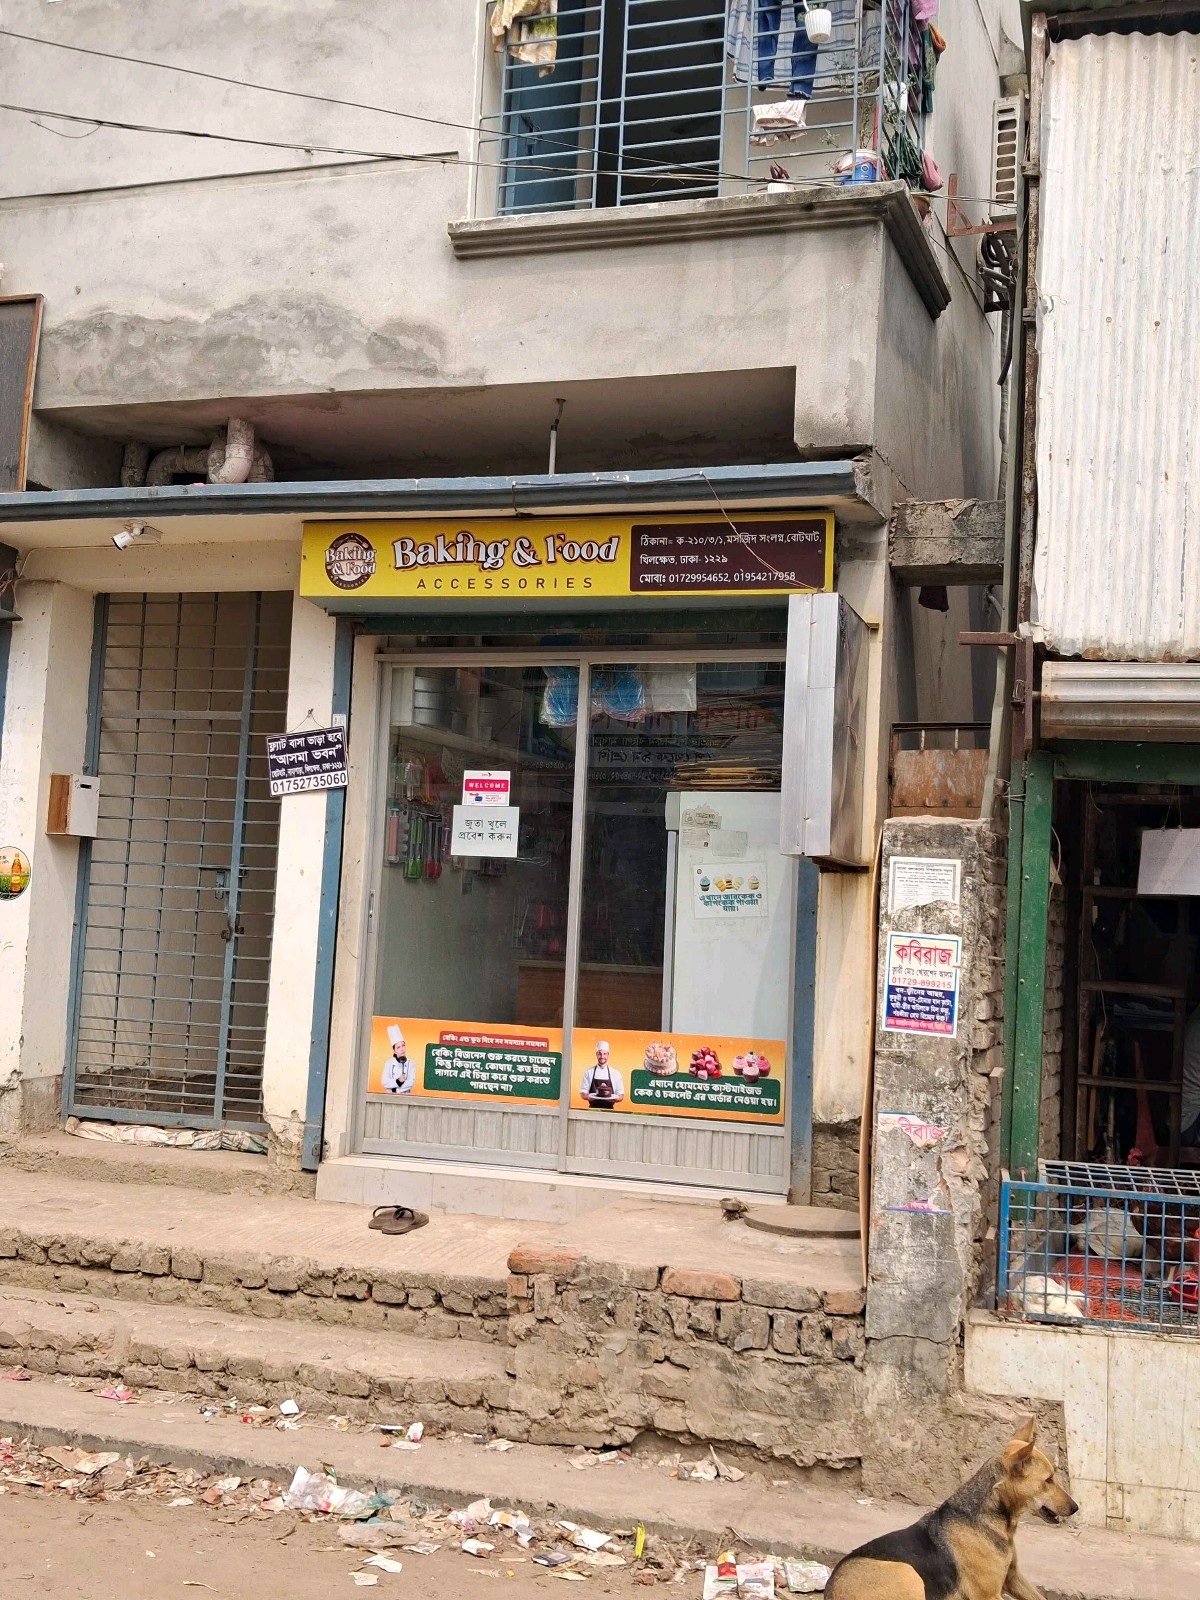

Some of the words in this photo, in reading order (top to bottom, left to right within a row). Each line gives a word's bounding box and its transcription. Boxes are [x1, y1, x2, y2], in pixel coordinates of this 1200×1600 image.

[324, 546, 377, 563] Baking
[392, 529, 509, 572] Baking
[511, 537, 542, 567] &
[545, 533, 620, 565] Food
[704, 554, 728, 563] ১২২৯
[331, 562, 344, 575] &
[345, 561, 376, 575] Food
[417, 577, 593, 589] ACCESSORIES
[669, 573, 731, 583] 01729954652,
[734, 572, 796, 582] 01954217958
[288, 737, 305, 748] বাসা
[306, 734, 326, 746] ভাড়া
[327, 732, 342, 742] হবে
[272, 772, 346, 793] 01752735060
[465, 819, 483, 830] জুতা
[488, 820, 507, 831] খুলে
[458, 831, 484, 841] প্রবেশ
[488, 832, 512, 842] করুন
[894, 939, 953, 967] কবিরাজ
[443, 1034, 458, 1042] বেকিং
[431, 1047, 453, 1057] বেকিং
[454, 1048, 486, 1059] বিজনেস
[504, 1054, 528, 1063] করতে
[529, 1055, 556, 1066] চাচ্ছেন
[435, 1057, 451, 1069] কিন্তু
[516, 1064, 531, 1072] কত
[532, 1064, 551, 1074] টাকা
[435, 1068, 458, 1078] লাগবে
[460, 1069, 471, 1079] এই
[472, 1070, 489, 1080] চিন্তা
[491, 1073, 507, 1081] করে
[526, 1075, 550, 1084] করতে
[470, 1081, 499, 1092] পারছেন
[649, 1079, 673, 1088] এখানে
[675, 1081, 710, 1091] হোমমেড
[634, 1088, 653, 1097] কেক
[654, 1089, 661, 1098] ও
[662, 1090, 692, 1100] চকলেট
[693, 1093, 706, 1101] এর
[707, 1091, 732, 1104] অর্ডার
